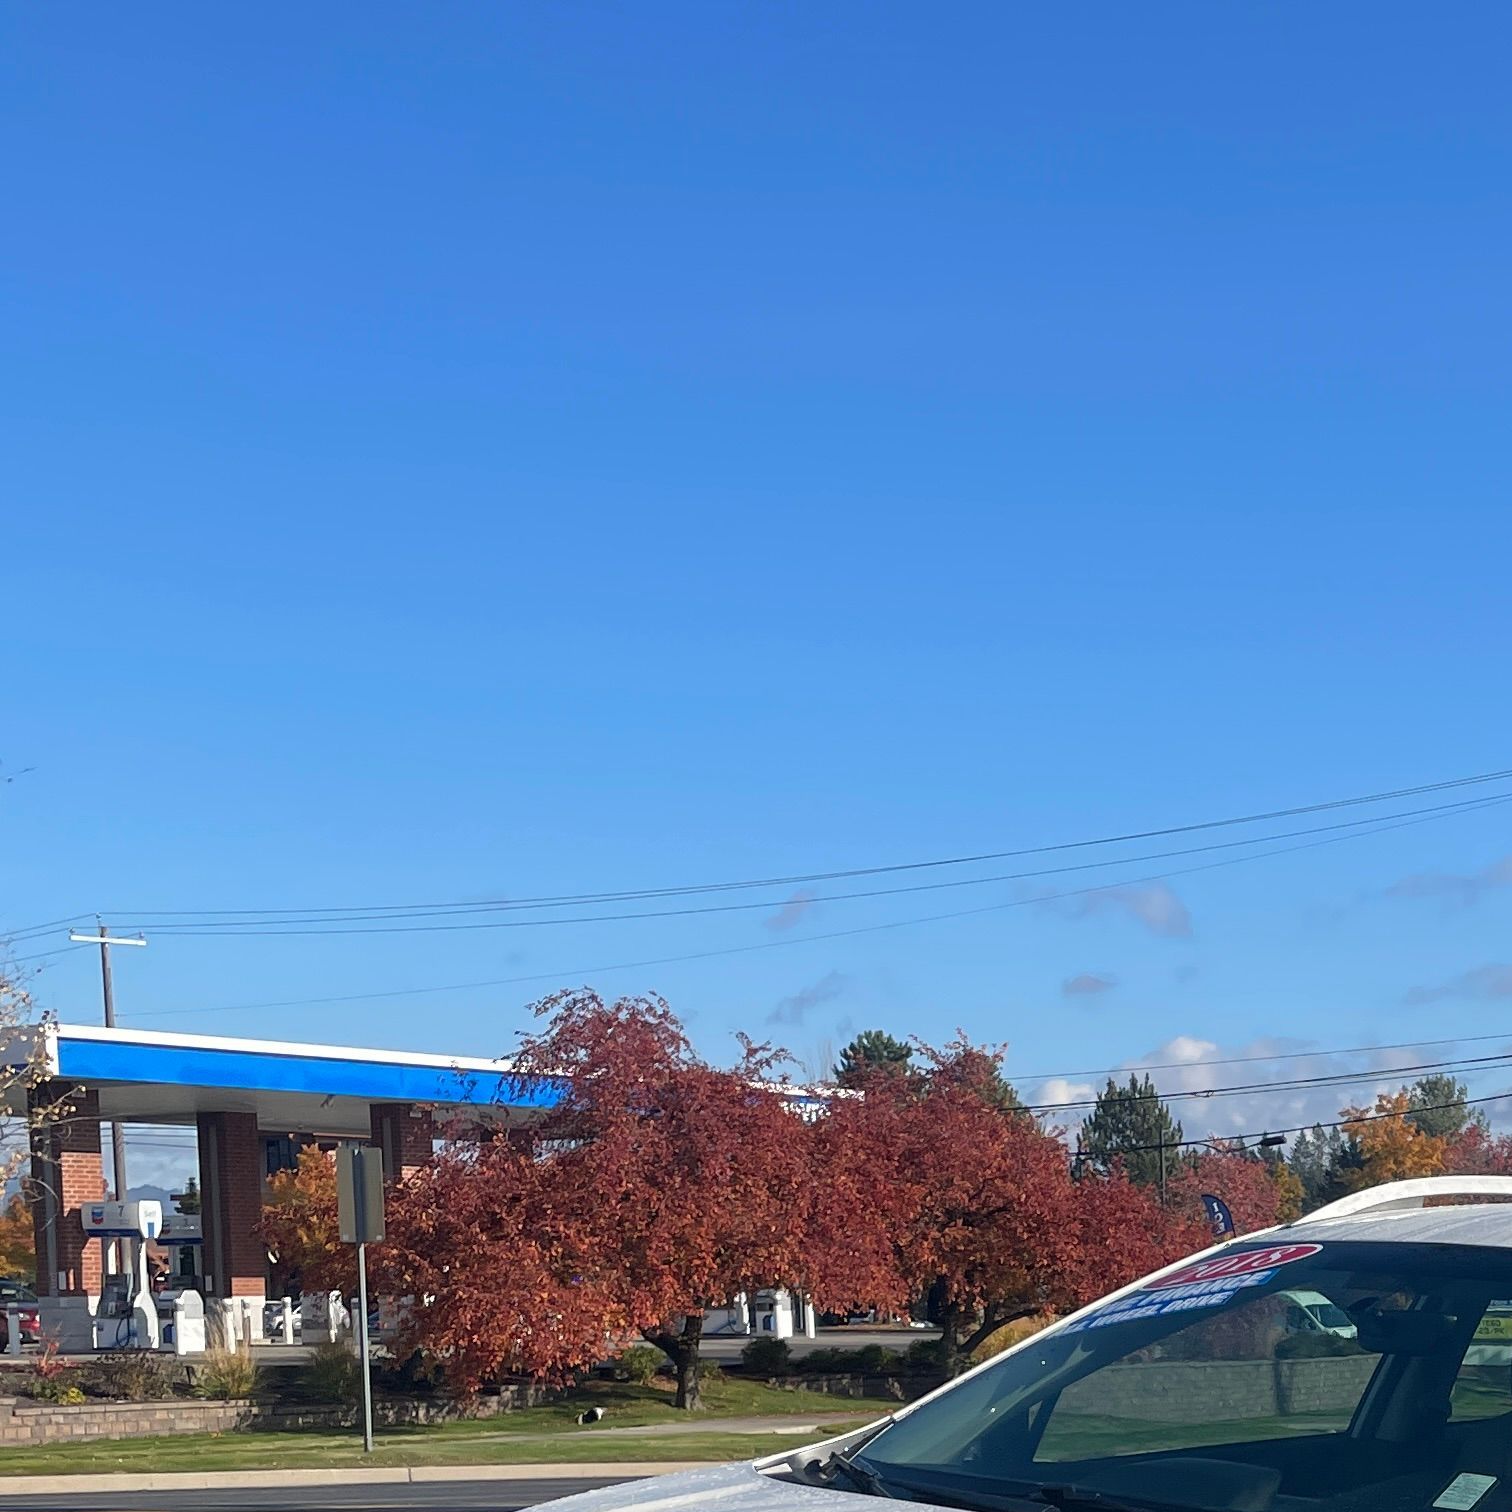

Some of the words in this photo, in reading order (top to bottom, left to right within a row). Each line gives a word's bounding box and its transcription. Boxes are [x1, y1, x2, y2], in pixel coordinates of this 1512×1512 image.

[1162, 1247, 1296, 1286] 2018
[1137, 1270, 1272, 1306] FINANCE
[1088, 1303, 1163, 1328] WHEEL
[1160, 1291, 1233, 1313] DRIVE
